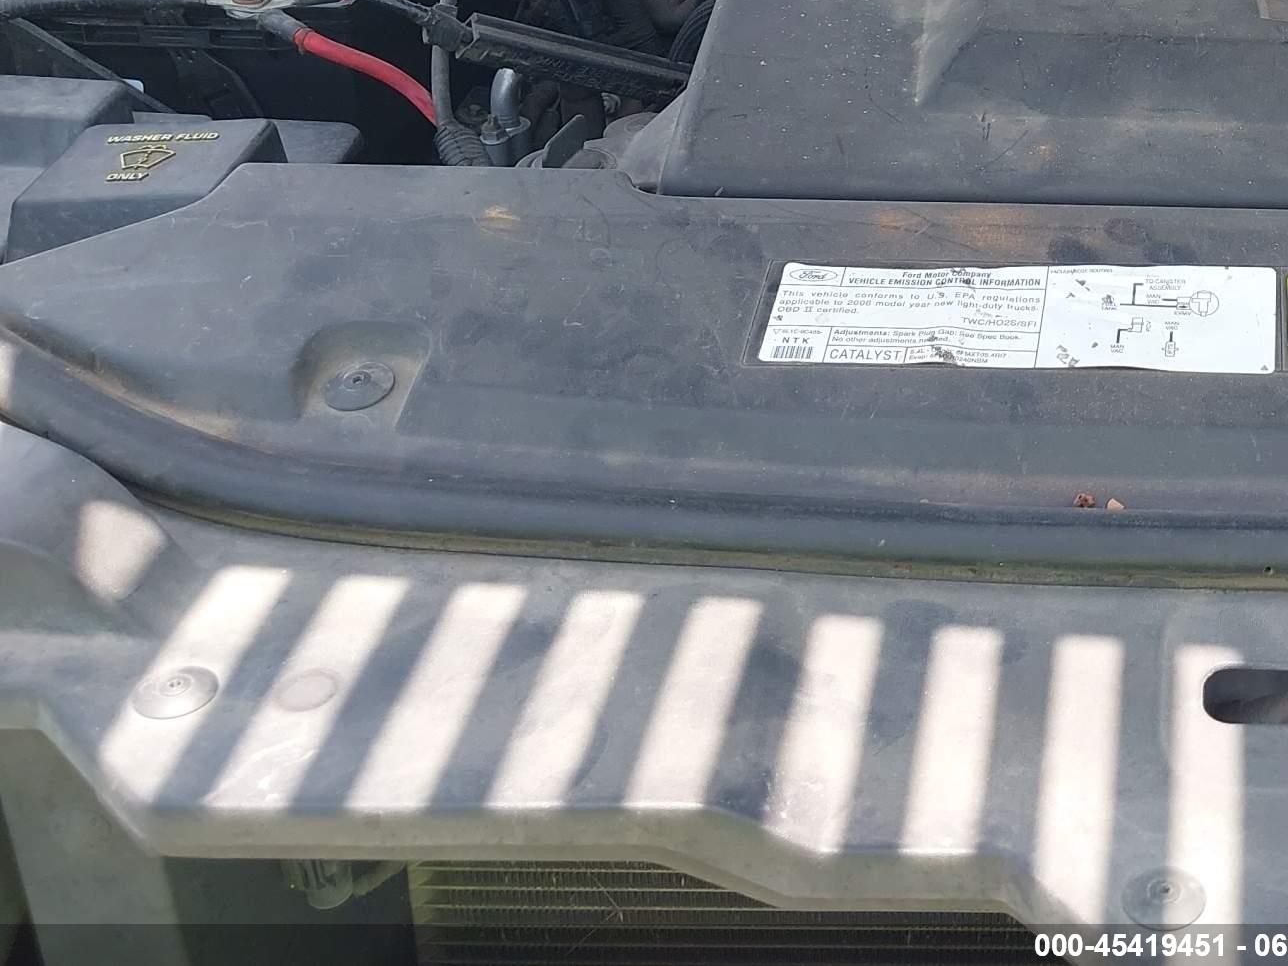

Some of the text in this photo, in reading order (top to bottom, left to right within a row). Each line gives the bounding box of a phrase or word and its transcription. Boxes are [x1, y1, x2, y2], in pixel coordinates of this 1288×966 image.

[107, 131, 219, 143] WASHER FLUID
[106, 172, 149, 181] ONLY
[799, 270, 828, 281] Ford
[902, 270, 992, 279] Ford Motor Company
[848, 277, 1041, 286] VEHICLE EMISSION CONTROL INFORMATION
[855, 292, 904, 300] conforms
[910, 292, 921, 300] to
[927, 292, 948, 300] U.S.
[955, 292, 976, 300] EPA
[982, 294, 1041, 304] regulations
[779, 298, 830, 306] applicable
[875, 299, 906, 307] model
[909, 300, 932, 309] year
[933, 299, 954, 307] new
[957, 299, 1004, 311] light-duty
[833, 328, 890, 337] Adjustments:
[892, 330, 917, 338] Spark
[918, 329, 936, 338] Plug
[867, 336, 917, 345] adjustments
[828, 348, 903, 361] CATALYST
